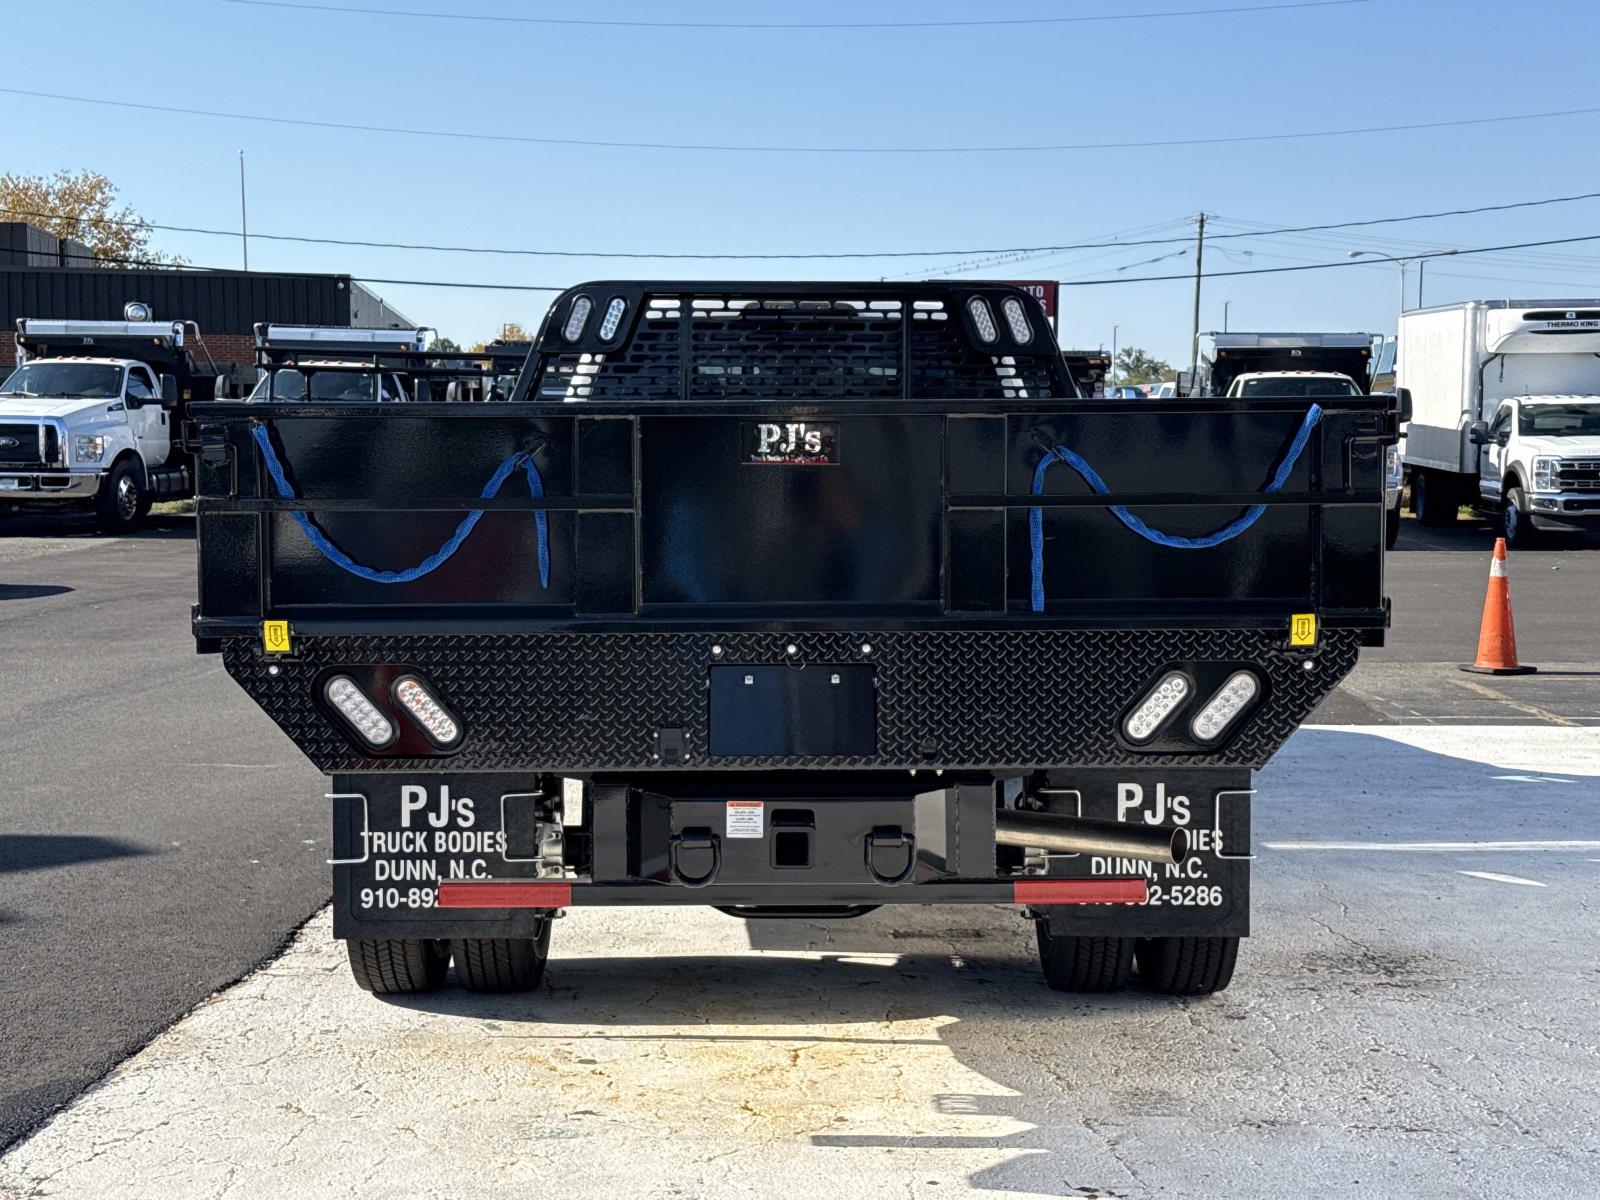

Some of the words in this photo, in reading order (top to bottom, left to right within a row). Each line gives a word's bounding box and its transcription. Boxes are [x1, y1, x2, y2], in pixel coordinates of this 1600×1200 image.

[757, 423, 821, 453] PJ's
[434, 831, 508, 853] BODIES
[375, 859, 443, 886] DUNN,
[449, 858, 493, 879] N.C.
[1091, 856, 1158, 882] DUNN,
[1165, 856, 1208, 879] N.C.
[1144, 885, 1222, 906] 2-5286
